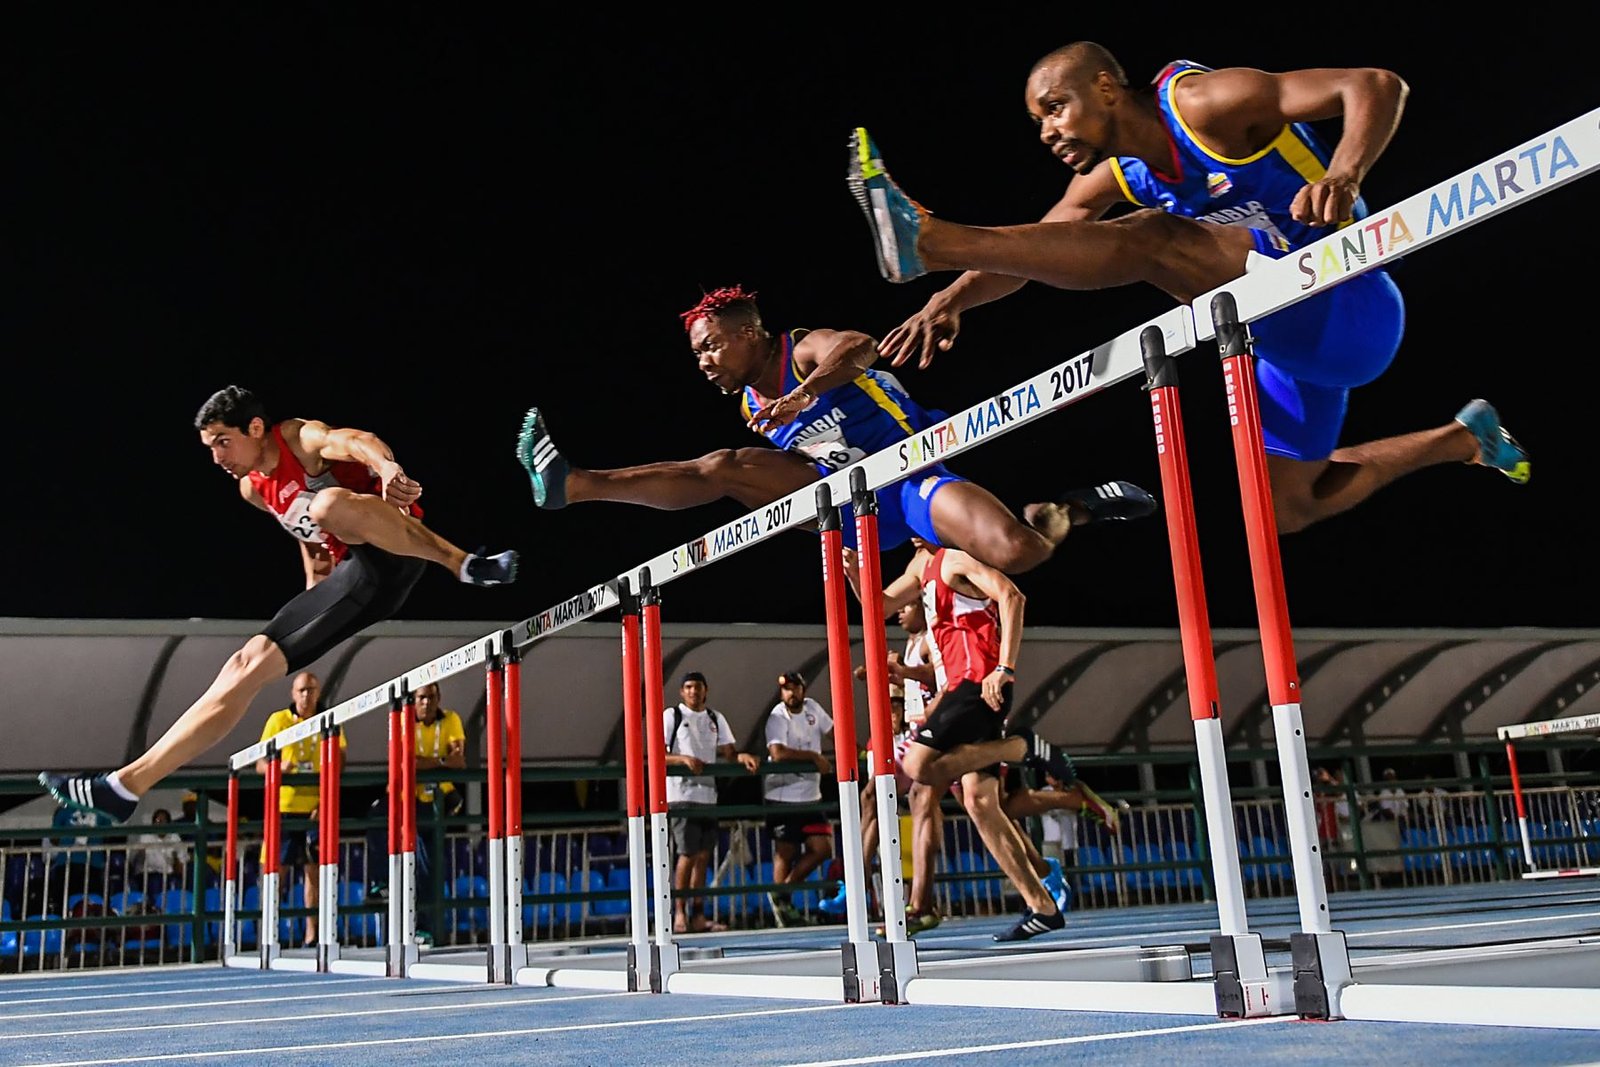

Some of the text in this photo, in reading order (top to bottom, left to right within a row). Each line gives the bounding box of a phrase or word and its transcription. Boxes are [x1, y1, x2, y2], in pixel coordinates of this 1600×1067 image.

[1298, 136, 1579, 291] SANTA MARTA
[899, 353, 1095, 472] SANTA MARTA 2017
[672, 498, 793, 573] SANTA MARTA 2017
[526, 585, 606, 640] SANTA MARTA 2017
